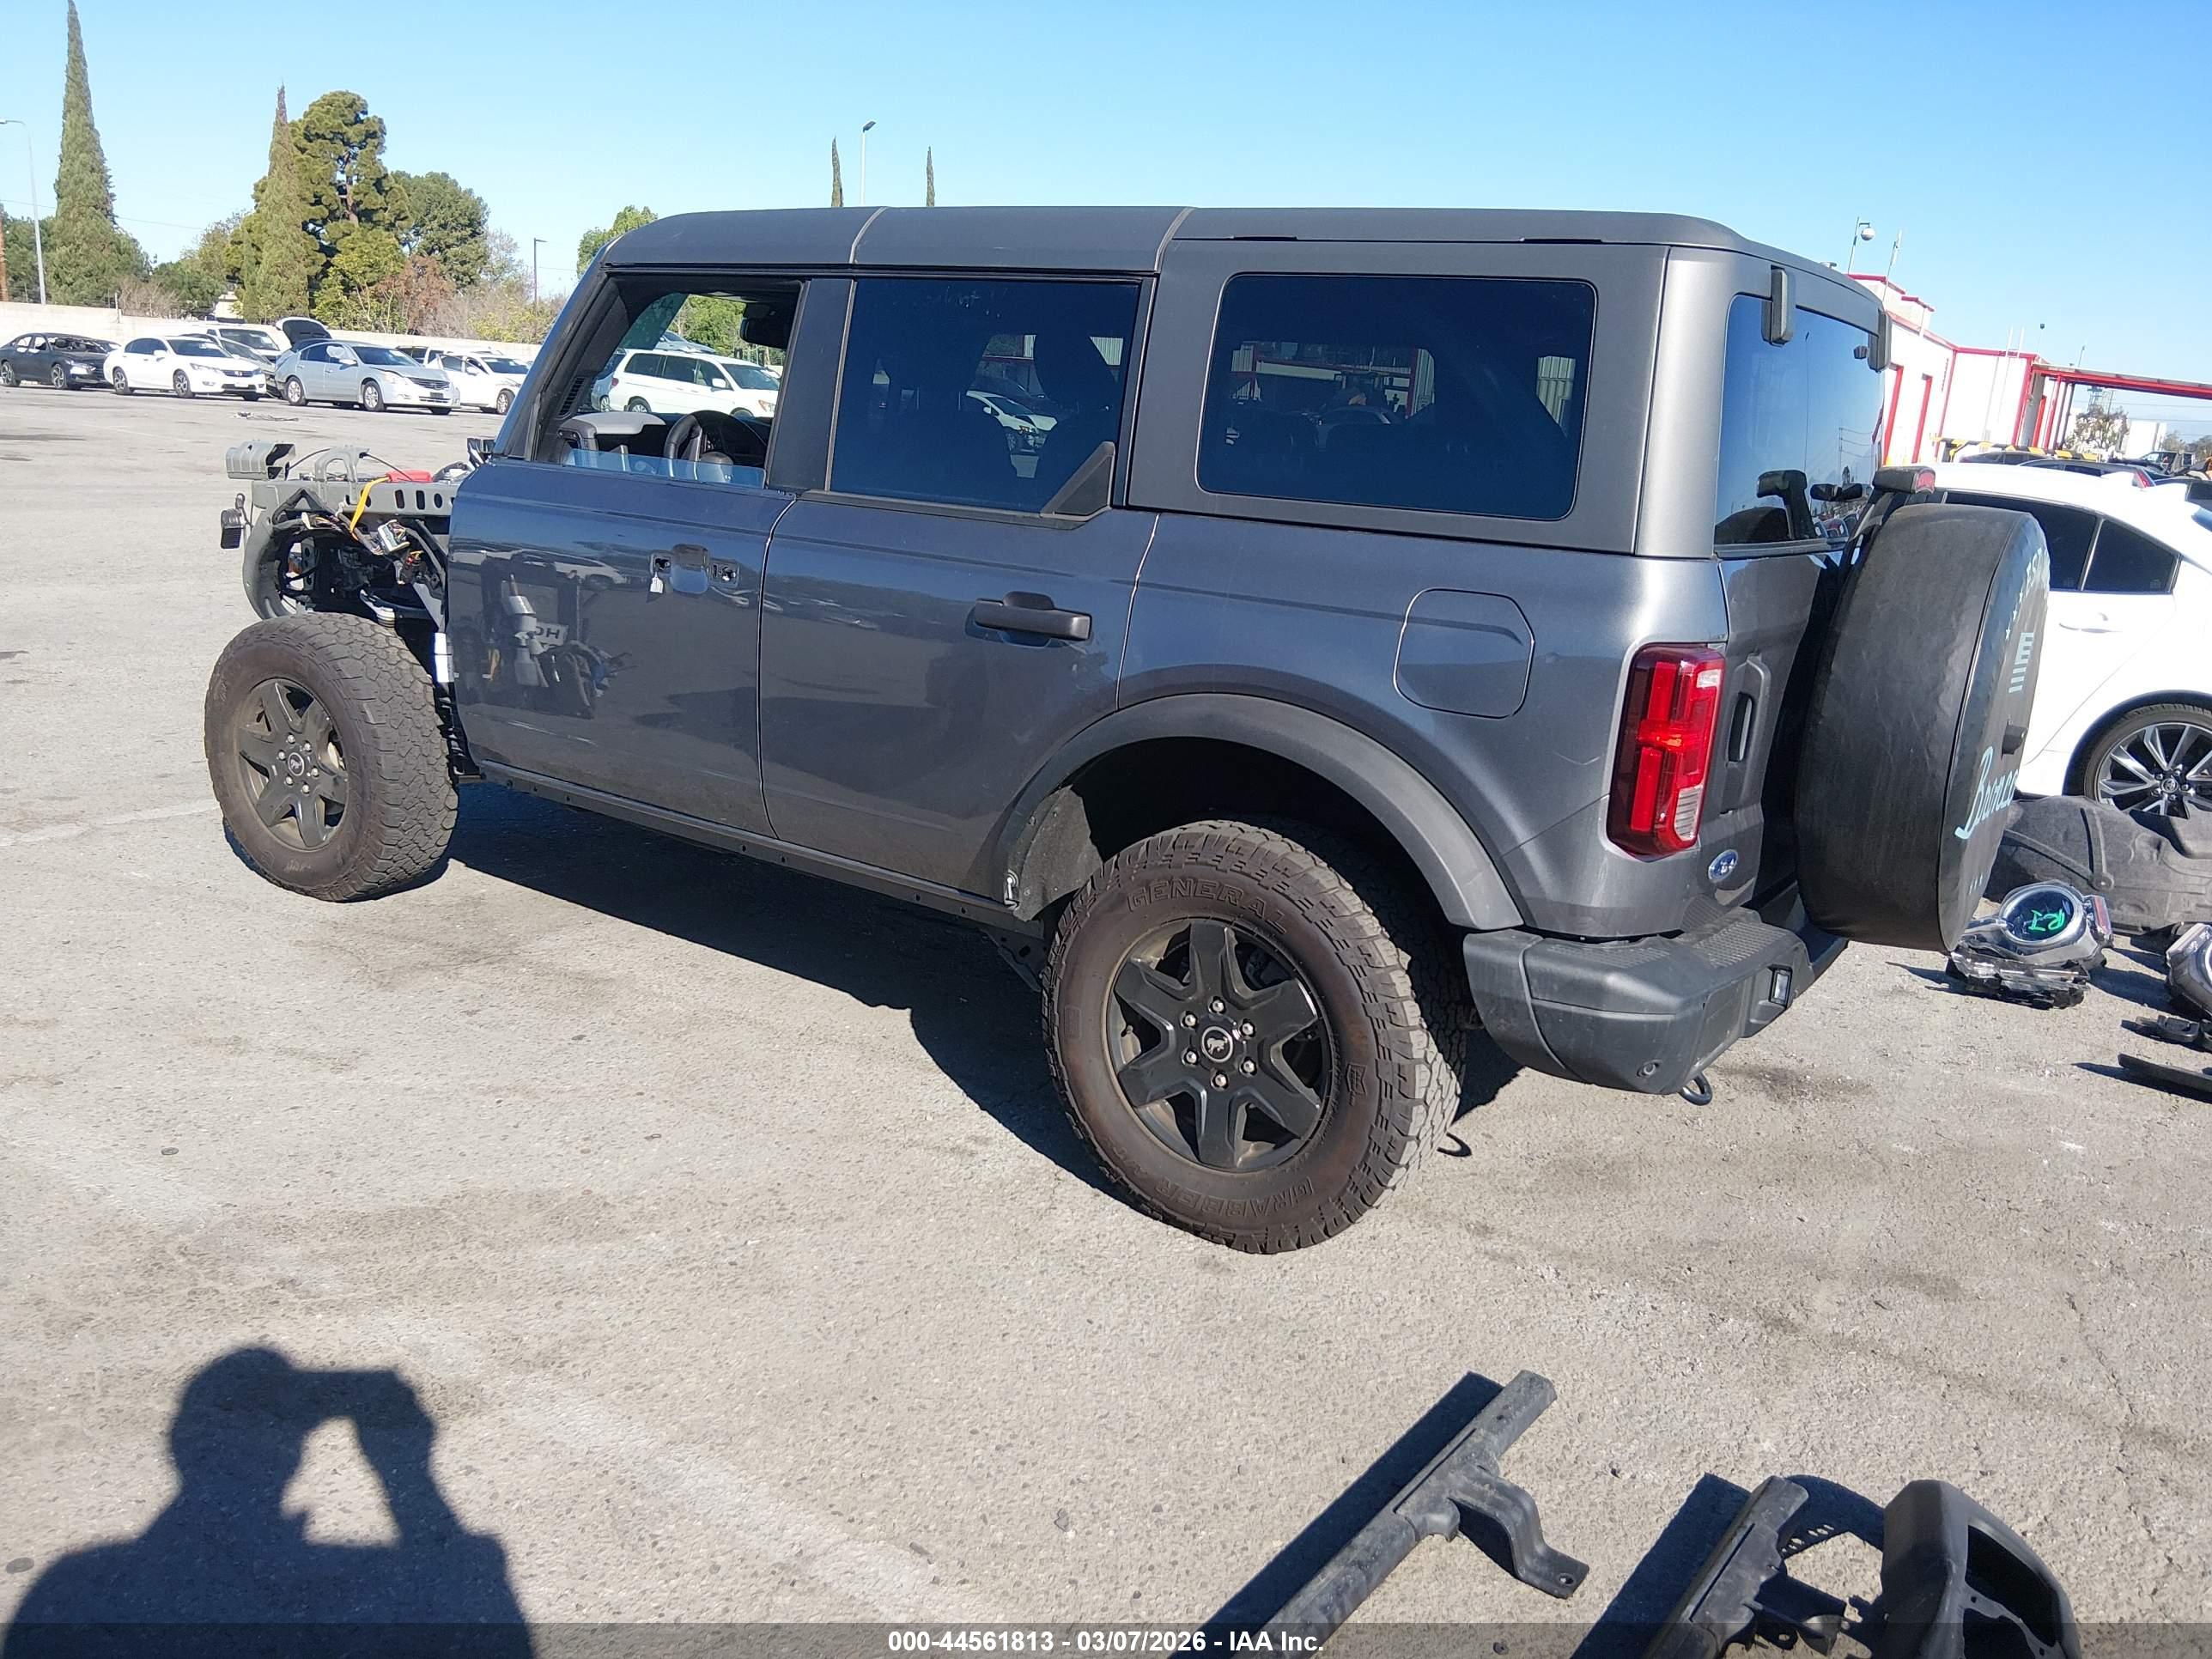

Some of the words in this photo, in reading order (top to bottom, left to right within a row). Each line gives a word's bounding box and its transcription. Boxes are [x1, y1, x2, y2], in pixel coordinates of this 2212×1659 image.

[1954, 744, 2019, 840] Bronco
[1127, 878, 1287, 935] GENERAL
[1156, 1176, 1314, 1218] GRABBER
